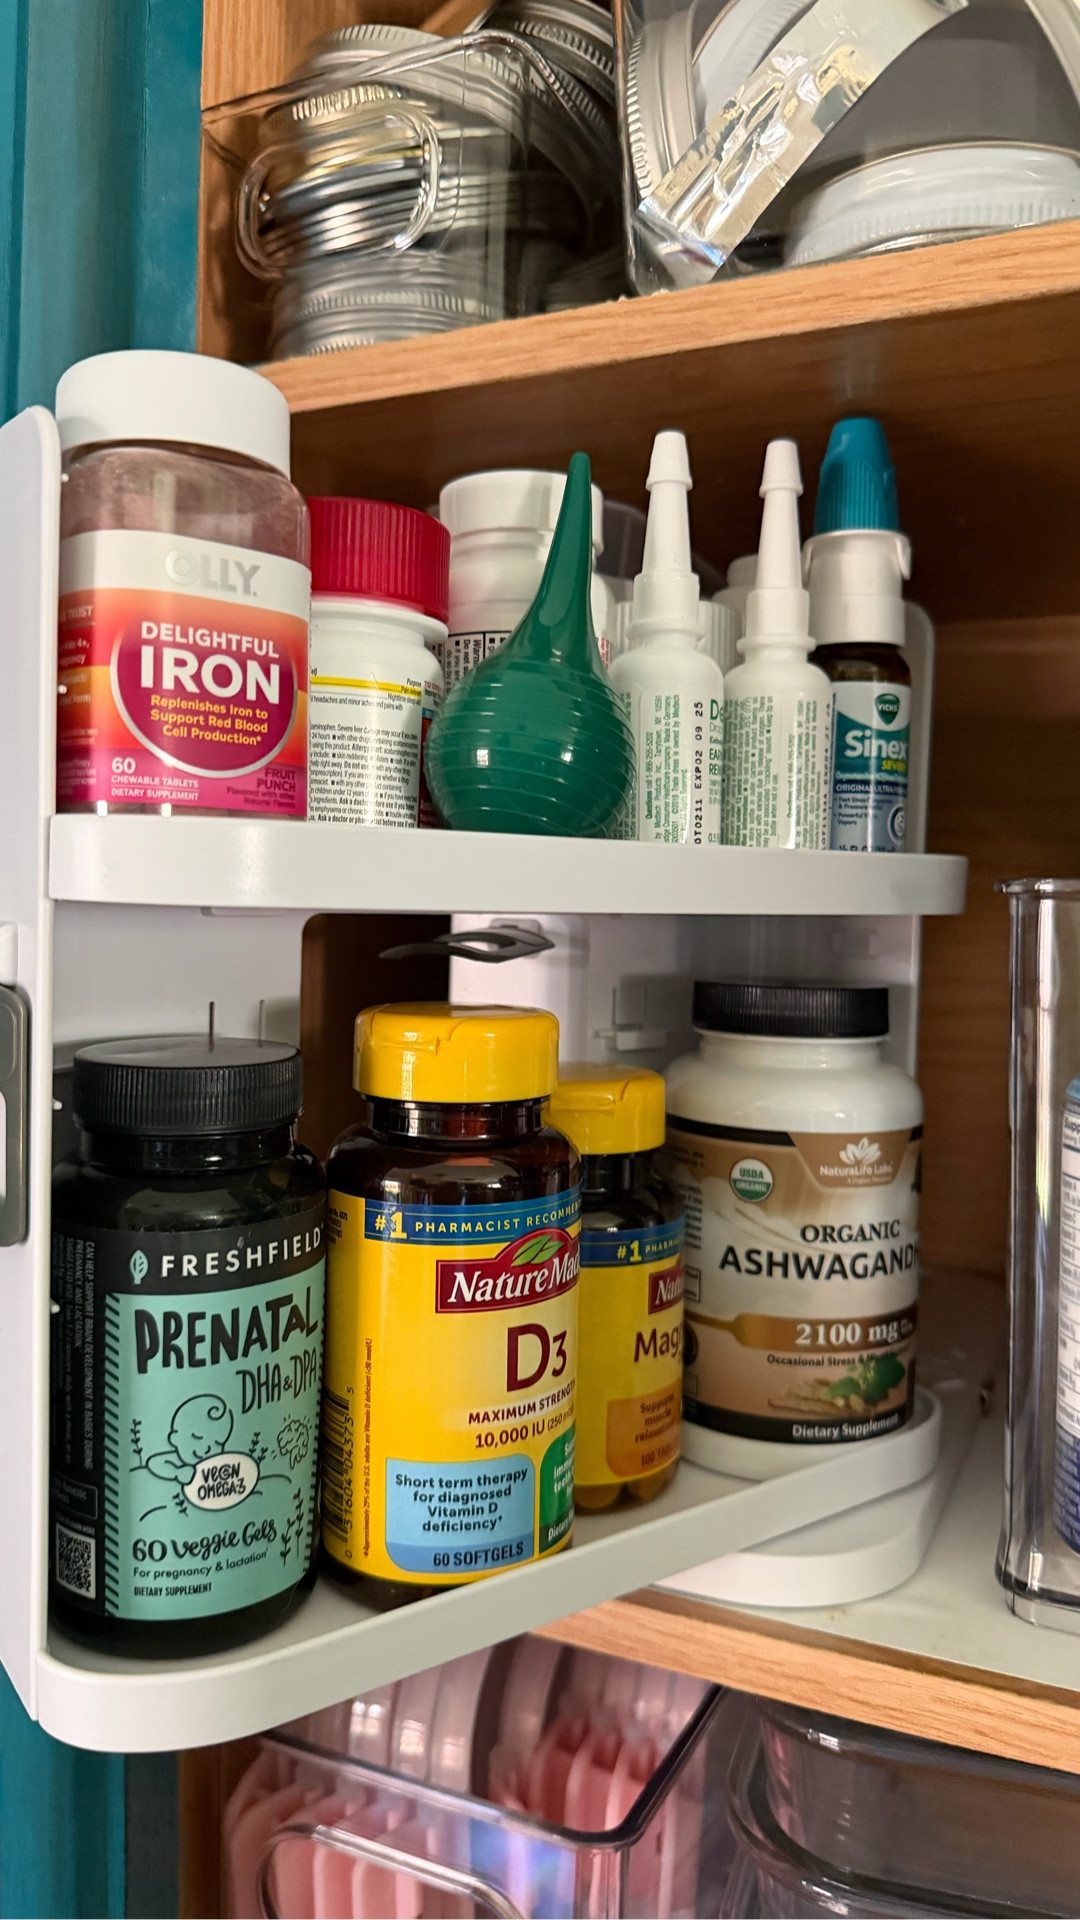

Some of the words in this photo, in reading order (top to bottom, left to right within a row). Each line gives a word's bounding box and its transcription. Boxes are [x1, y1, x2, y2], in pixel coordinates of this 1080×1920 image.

[141, 621, 280, 658] DELIGHTFUL
[464, 640, 470, 649] Do
[140, 645, 280, 705] IRON
[151, 694, 226, 714] Replenishes
[230, 704, 252, 717] Iron
[256, 708, 268, 720] to
[694, 702, 703, 717] 25
[877, 704, 898, 712] VICKS
[150, 709, 204, 725] Support
[208, 716, 232, 728] Red
[235, 720, 268, 733] Blood
[655, 717, 661, 725] NY
[162, 725, 187, 738] Cell
[695, 726, 702, 740] 09
[844, 729, 908, 760] Sinex
[112, 758, 136, 774] 60
[264, 768, 296, 780] FRUIT
[111, 776, 160, 786] CHEWABLE
[162, 778, 199, 788] TABLETS
[256, 780, 296, 792] PUNCH
[111, 788, 144, 797] DIETARY
[146, 790, 199, 800] SUPPLEMENT
[339, 797, 348, 805] Ask
[739, 1168, 764, 1179] USDA
[820, 1165, 872, 1176] NaturaLife
[874, 1164, 892, 1174] Labs
[736, 1181, 767, 1192] ORGANIC
[375, 1212, 407, 1239] #1
[416, 1218, 520, 1233] PHARMACIST
[800, 1220, 900, 1243] ORGANIC
[85, 1242, 95, 1259] CAN
[161, 1227, 321, 1278] FRESHFIELD
[616, 1240, 642, 1262] #1
[75, 1240, 83, 1286] PREGNANCY
[85, 1260, 94, 1280] HELP
[75, 1287, 83, 1304] AND
[448, 1268, 548, 1303] Nature
[85, 1281, 94, 1316] SUPPORT
[85, 1318, 94, 1343] BRAIN
[134, 1286, 318, 1374] PRENATAL
[794, 1322, 861, 1346] 2100
[868, 1321, 899, 1342] mg
[507, 1323, 567, 1392] D3
[767, 1354, 824, 1366] Occasional
[827, 1355, 855, 1366] Stress
[84, 1344, 93, 1399] DEVELOPMENT
[235, 1362, 282, 1414] DHA
[283, 1376, 293, 1391] &
[290, 1347, 317, 1399] DPA
[346, 1386, 354, 1394] 5
[84, 1400, 93, 1410] IN
[469, 1402, 536, 1424] MAXIMUM
[84, 1410, 93, 1438] BABIES
[475, 1425, 528, 1448] 10,000
[532, 1419, 545, 1437] IU
[792, 1424, 840, 1439] Dietary
[842, 1414, 898, 1436] Supplement
[343, 1416, 354, 1469] 04373
[84, 1440, 93, 1470] DURING
[395, 1473, 435, 1488] Short
[438, 1477, 472, 1488] term
[476, 1468, 528, 1486] therapy
[343, 1478, 353, 1529] 31604
[413, 1490, 435, 1502] for
[438, 1485, 511, 1505] diagnosed
[427, 1504, 485, 1518] Vitamin
[488, 1502, 498, 1514] D
[132, 1538, 167, 1562] 60
[242, 1519, 277, 1546] Gels
[344, 1549, 353, 1559] 0
[433, 1553, 449, 1567] 60
[453, 1541, 524, 1565] SOFTGELS
[133, 1567, 151, 1578] For
[154, 1565, 212, 1580] pregnancy
[215, 1561, 223, 1571] &
[134, 1586, 163, 1596] DIETARY
[166, 1582, 212, 1596] SUPPLEMENT
